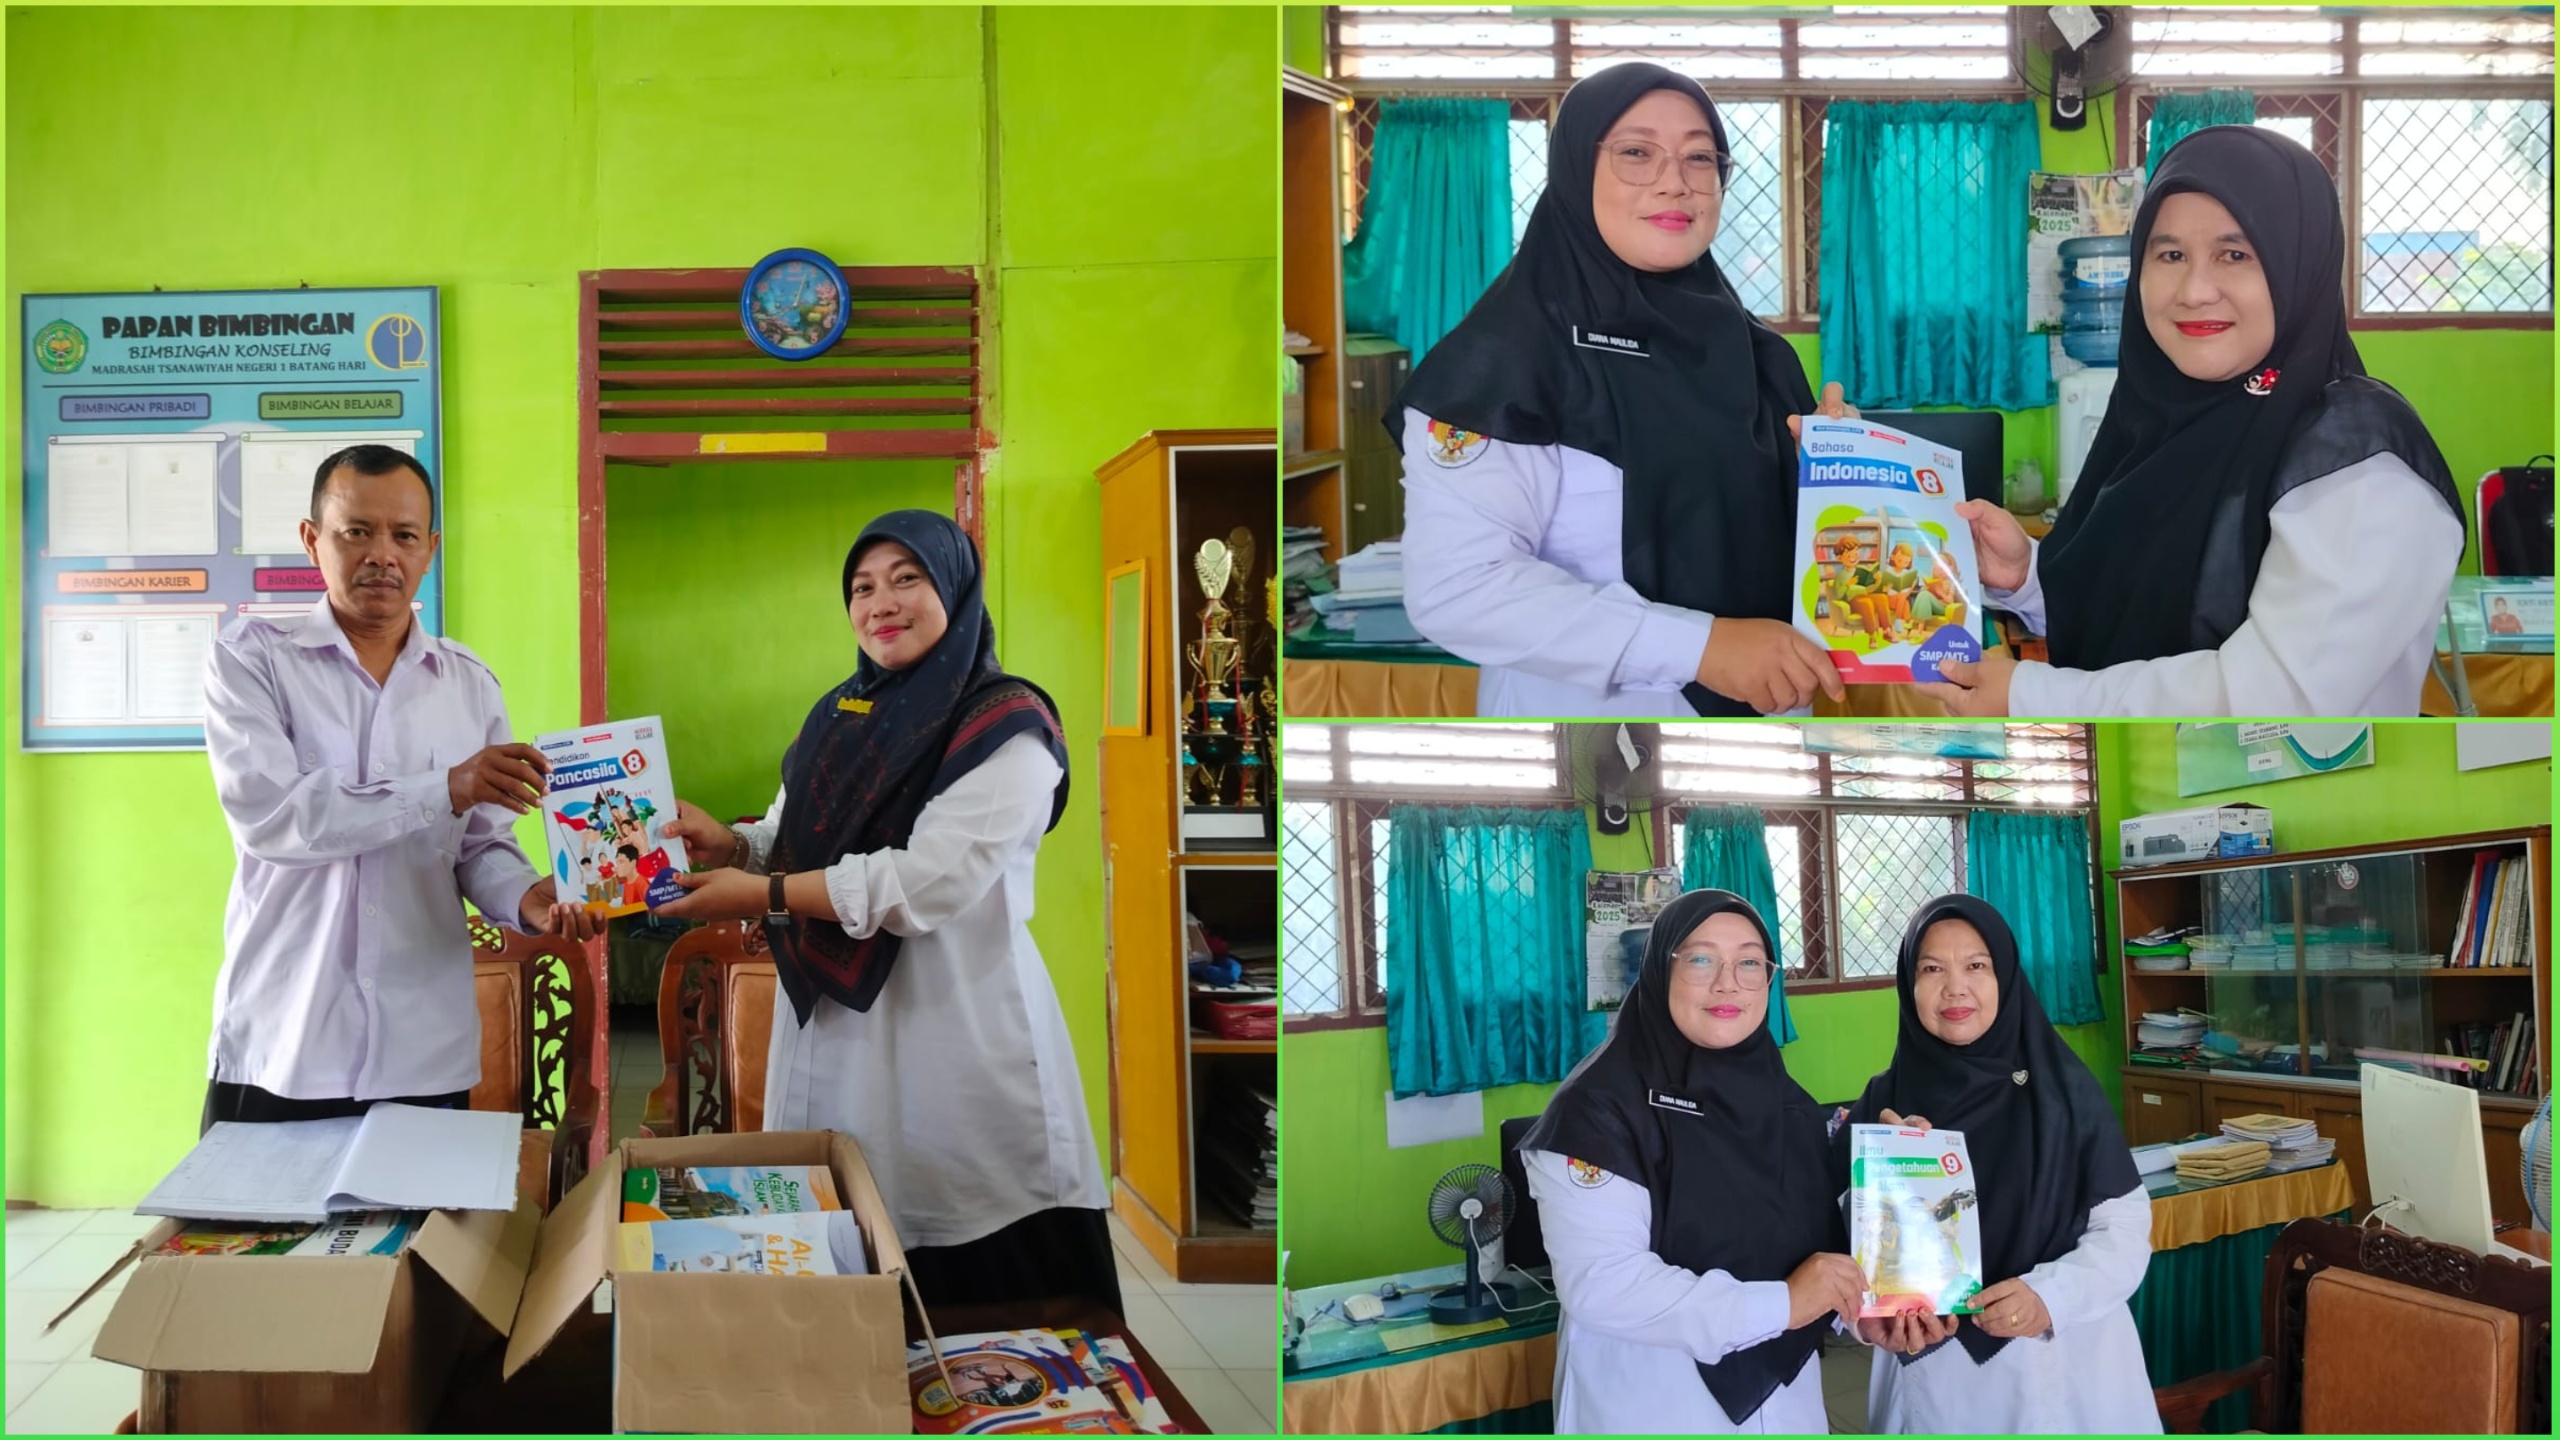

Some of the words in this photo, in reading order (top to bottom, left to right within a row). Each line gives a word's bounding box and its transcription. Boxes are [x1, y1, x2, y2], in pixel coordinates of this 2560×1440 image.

[2041, 219, 2072, 231] 2025
[102, 315, 193, 339] PAPAN
[198, 312, 355, 337] BIMBINGAN
[128, 344, 230, 359] BIMBINGAN
[235, 343, 331, 358] KONSELING
[92, 364, 155, 374] MADRASAH
[158, 363, 233, 373] TSANAWIYAH
[236, 362, 277, 372] NEGERI
[281, 362, 286, 371] 1
[289, 361, 335, 371] BATANG
[338, 361, 366, 370] HARI
[74, 402, 145, 414] BIMBINGAN
[149, 402, 196, 412] PRIBADI
[269, 400, 340, 411] BIMBINGAN
[344, 399, 393, 409] BELAJAR
[1811, 442, 1854, 453] Bahasa
[1810, 462, 1907, 485] Indonesia
[1921, 471, 1939, 494] 8
[73, 578, 145, 588] BIMBINGAN
[149, 577, 191, 587] KARIER
[1948, 640, 1969, 649] Untuk
[1919, 650, 1970, 662] SMP/MTs
[549, 752, 590, 766] endidikan
[545, 762, 618, 787] Pancasila
[627, 754, 641, 772] 8
[2222, 811, 2238, 819] EPSON
[2121, 822, 2141, 830] EPSON
[1596, 911, 1621, 921] 2025
[1859, 1145, 1883, 1156] Ilmu
[1944, 1155, 1959, 1173] 9
[753, 1179, 767, 1202] ISLAM
[766, 1233, 784, 1246] &
